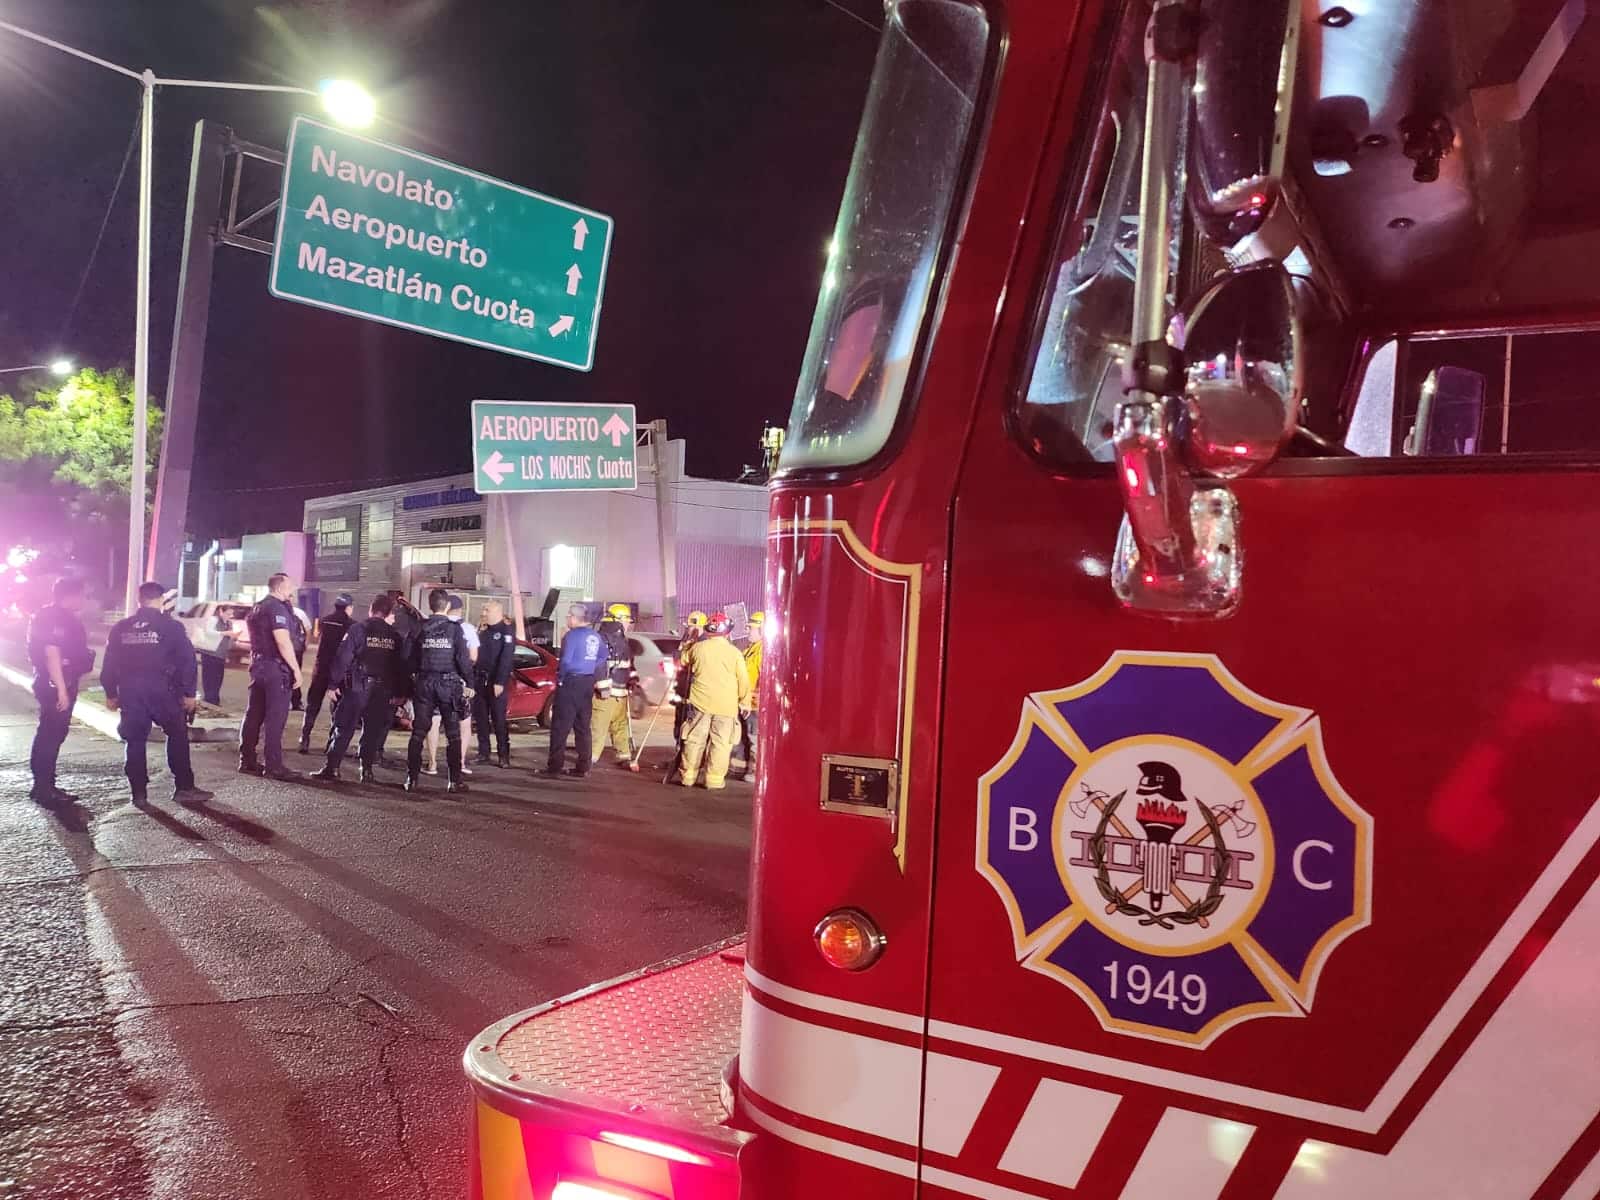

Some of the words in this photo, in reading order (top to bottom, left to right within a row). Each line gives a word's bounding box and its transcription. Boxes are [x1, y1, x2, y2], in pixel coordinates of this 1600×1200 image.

[310, 145, 454, 210] Navolato
[305, 195, 488, 268] Aeropuerto
[298, 242, 442, 304] Mazatlán
[450, 285, 535, 329] Cuota
[480, 415, 599, 441] AEROPUERTO
[521, 455, 543, 480] LOS
[550, 456, 591, 480] MOCHIS
[597, 456, 632, 479] Cuota
[121, 631, 160, 640] ICÍA
[1008, 806, 1039, 852] B
[1292, 840, 1334, 890] C
[1103, 961, 1207, 1016] 1949
